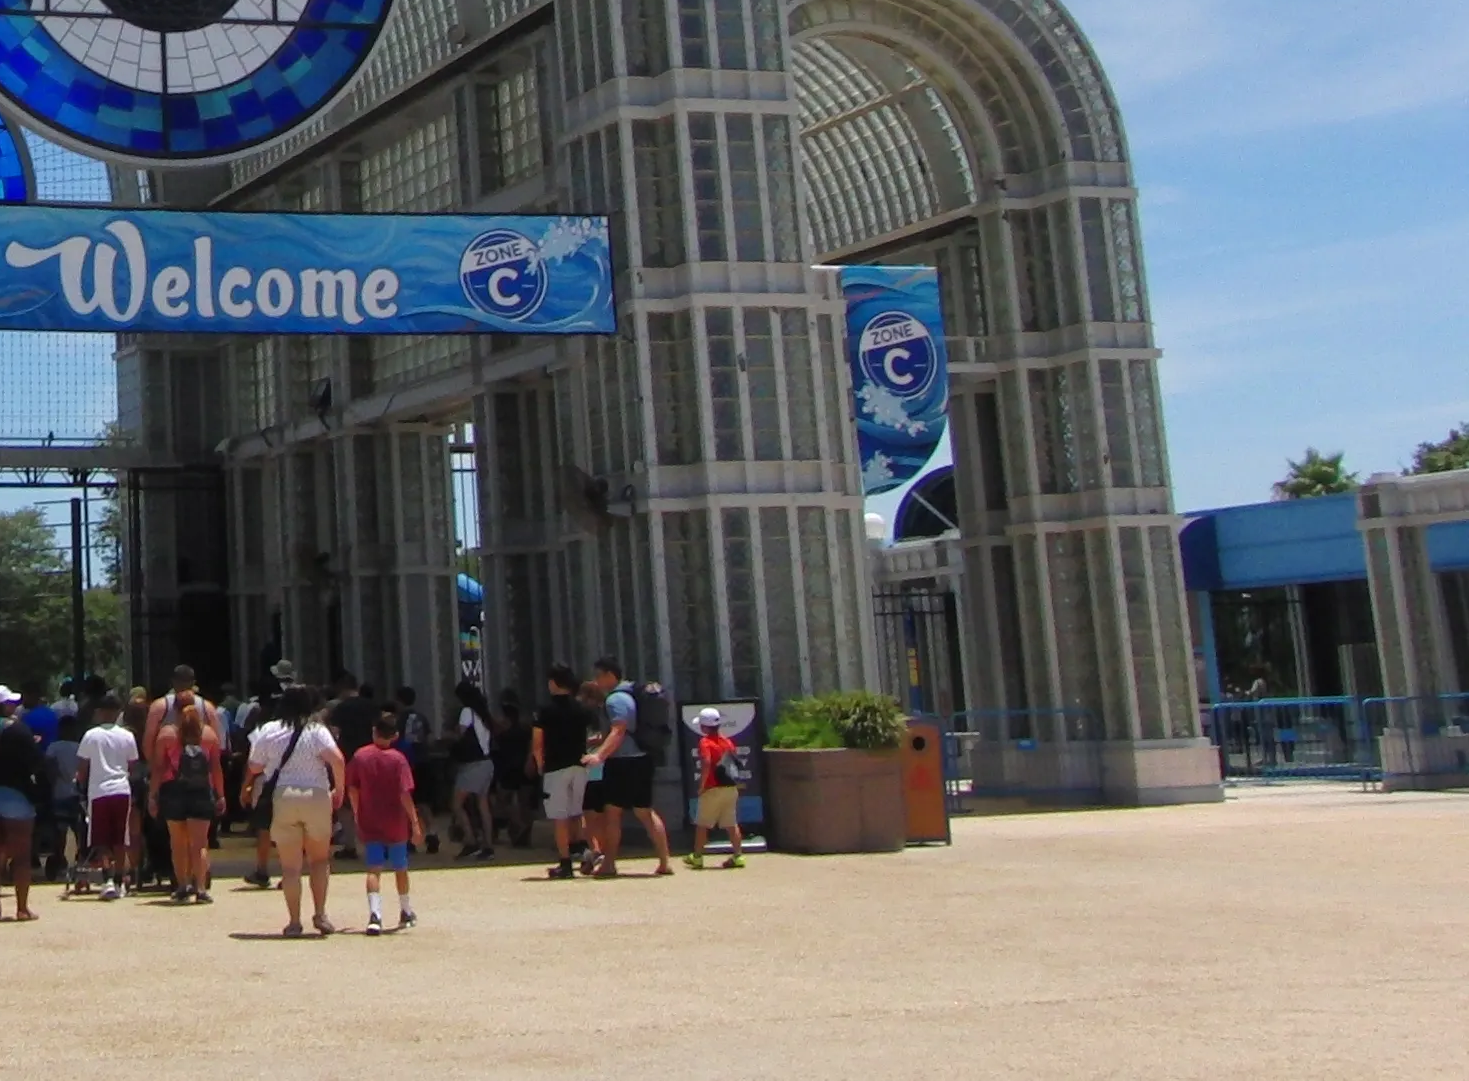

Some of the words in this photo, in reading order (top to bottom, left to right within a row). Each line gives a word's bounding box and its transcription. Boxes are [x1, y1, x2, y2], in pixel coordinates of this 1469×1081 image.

[5, 219, 400, 325] Welcome
[474, 242, 522, 266] ZONE
[488, 267, 521, 306] C
[871, 324, 914, 345] ZONE
[884, 348, 914, 384] C
